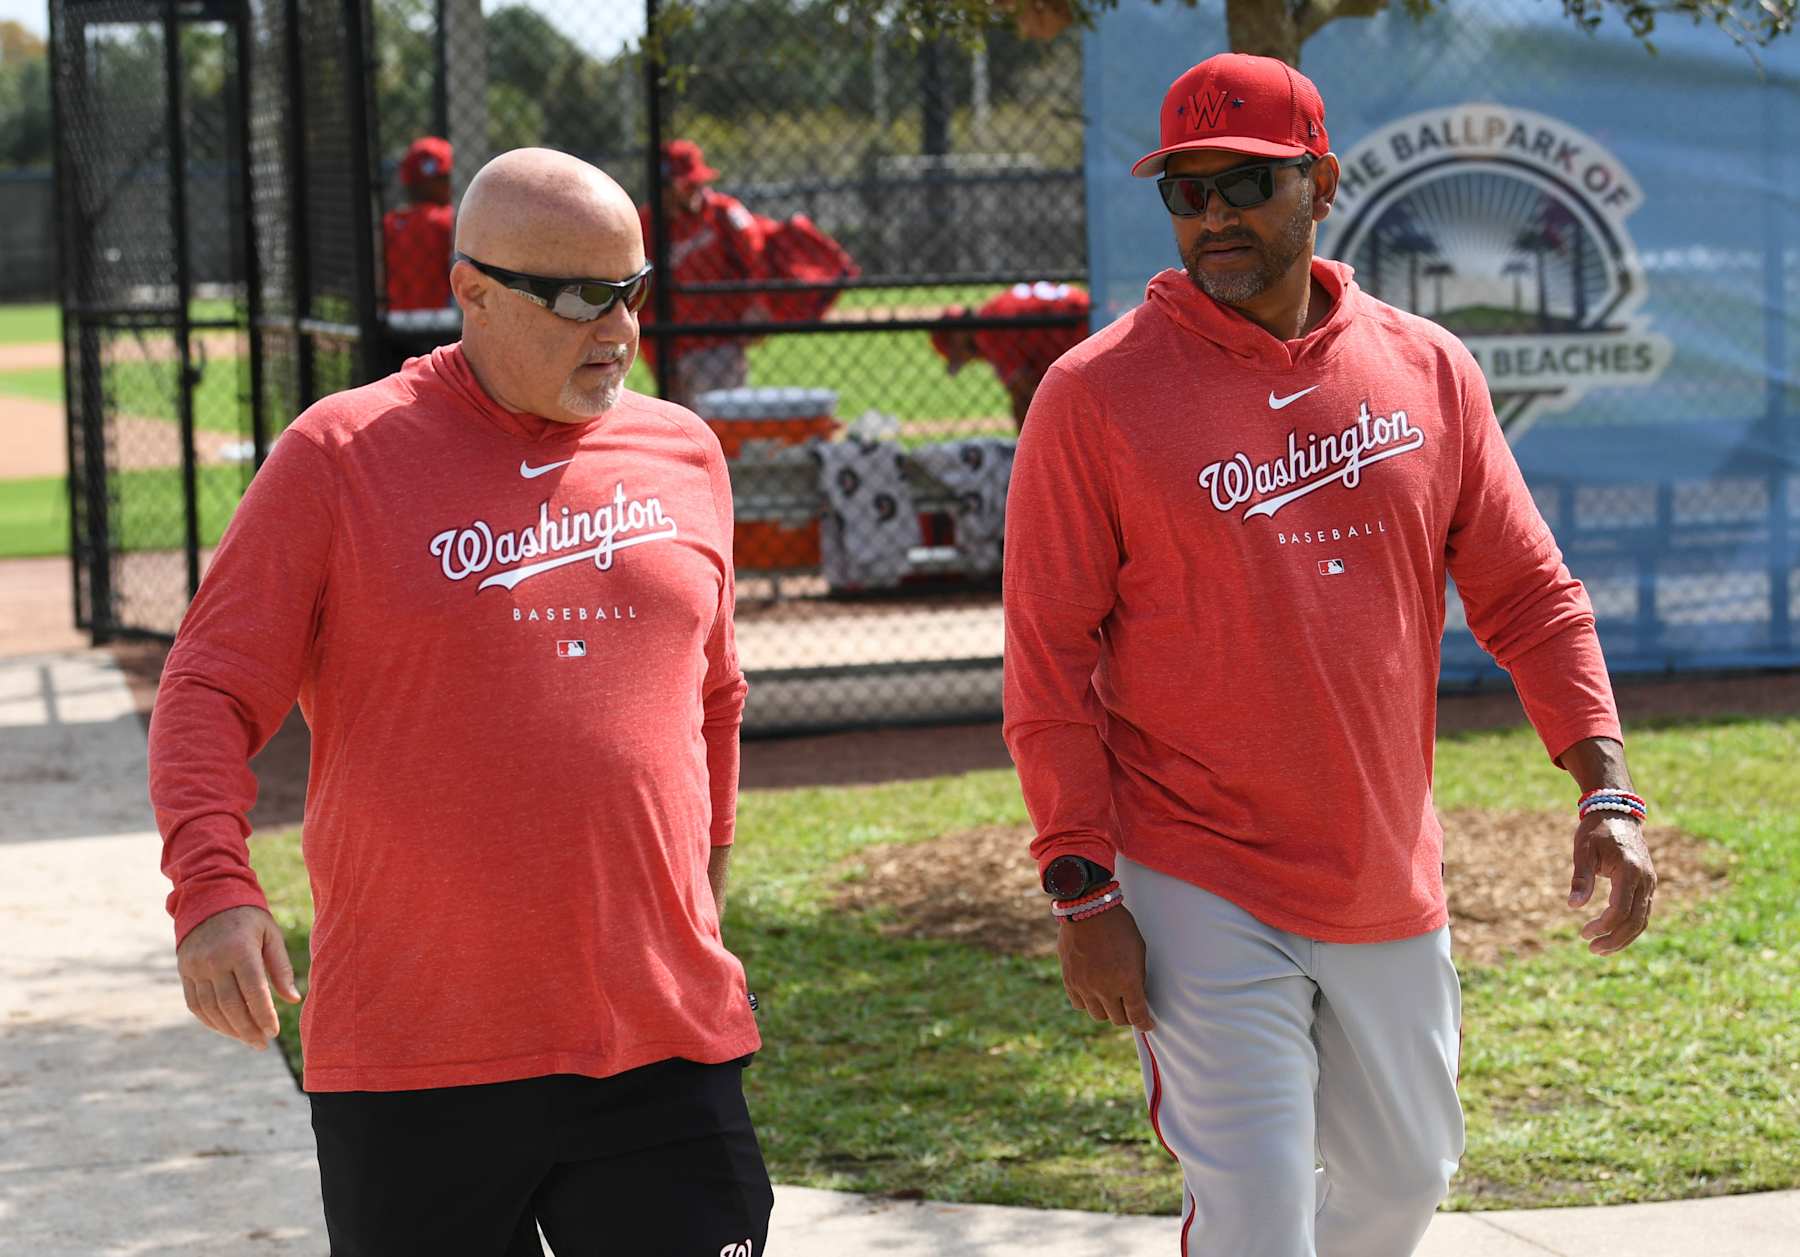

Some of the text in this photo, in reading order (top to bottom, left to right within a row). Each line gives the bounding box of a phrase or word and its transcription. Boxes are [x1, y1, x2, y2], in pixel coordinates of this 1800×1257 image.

[1389, 115, 1580, 173] BALLPARK
[1583, 164, 1631, 207] OF
[1493, 343, 1654, 377] BEACHES
[1198, 400, 1425, 525] Washington
[429, 480, 678, 596] Washington
[1278, 521, 1385, 544] BASEBALL
[512, 605, 637, 622] BASEBALL
